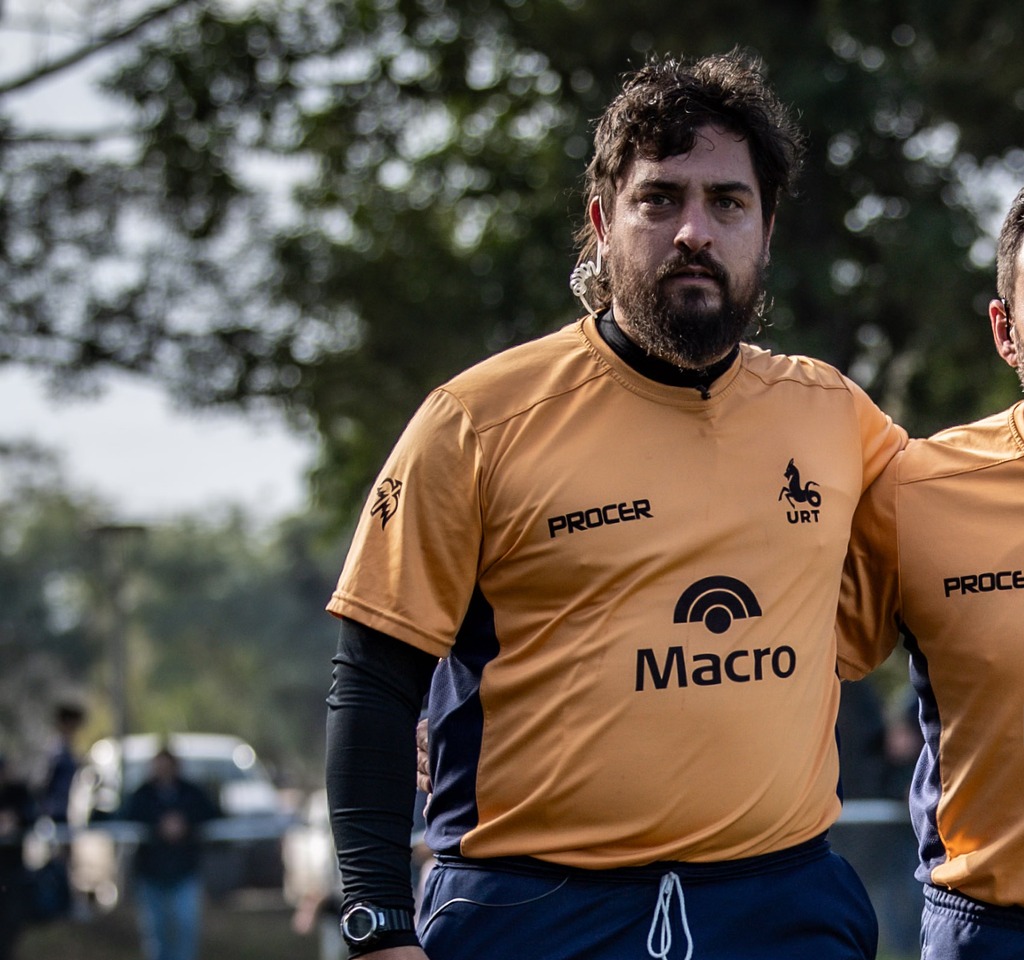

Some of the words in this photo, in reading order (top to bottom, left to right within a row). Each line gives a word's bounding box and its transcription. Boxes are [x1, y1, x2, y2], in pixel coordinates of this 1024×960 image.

[548, 498, 653, 538] PROCER
[786, 509, 821, 524] URT
[635, 645, 796, 692] Macro
